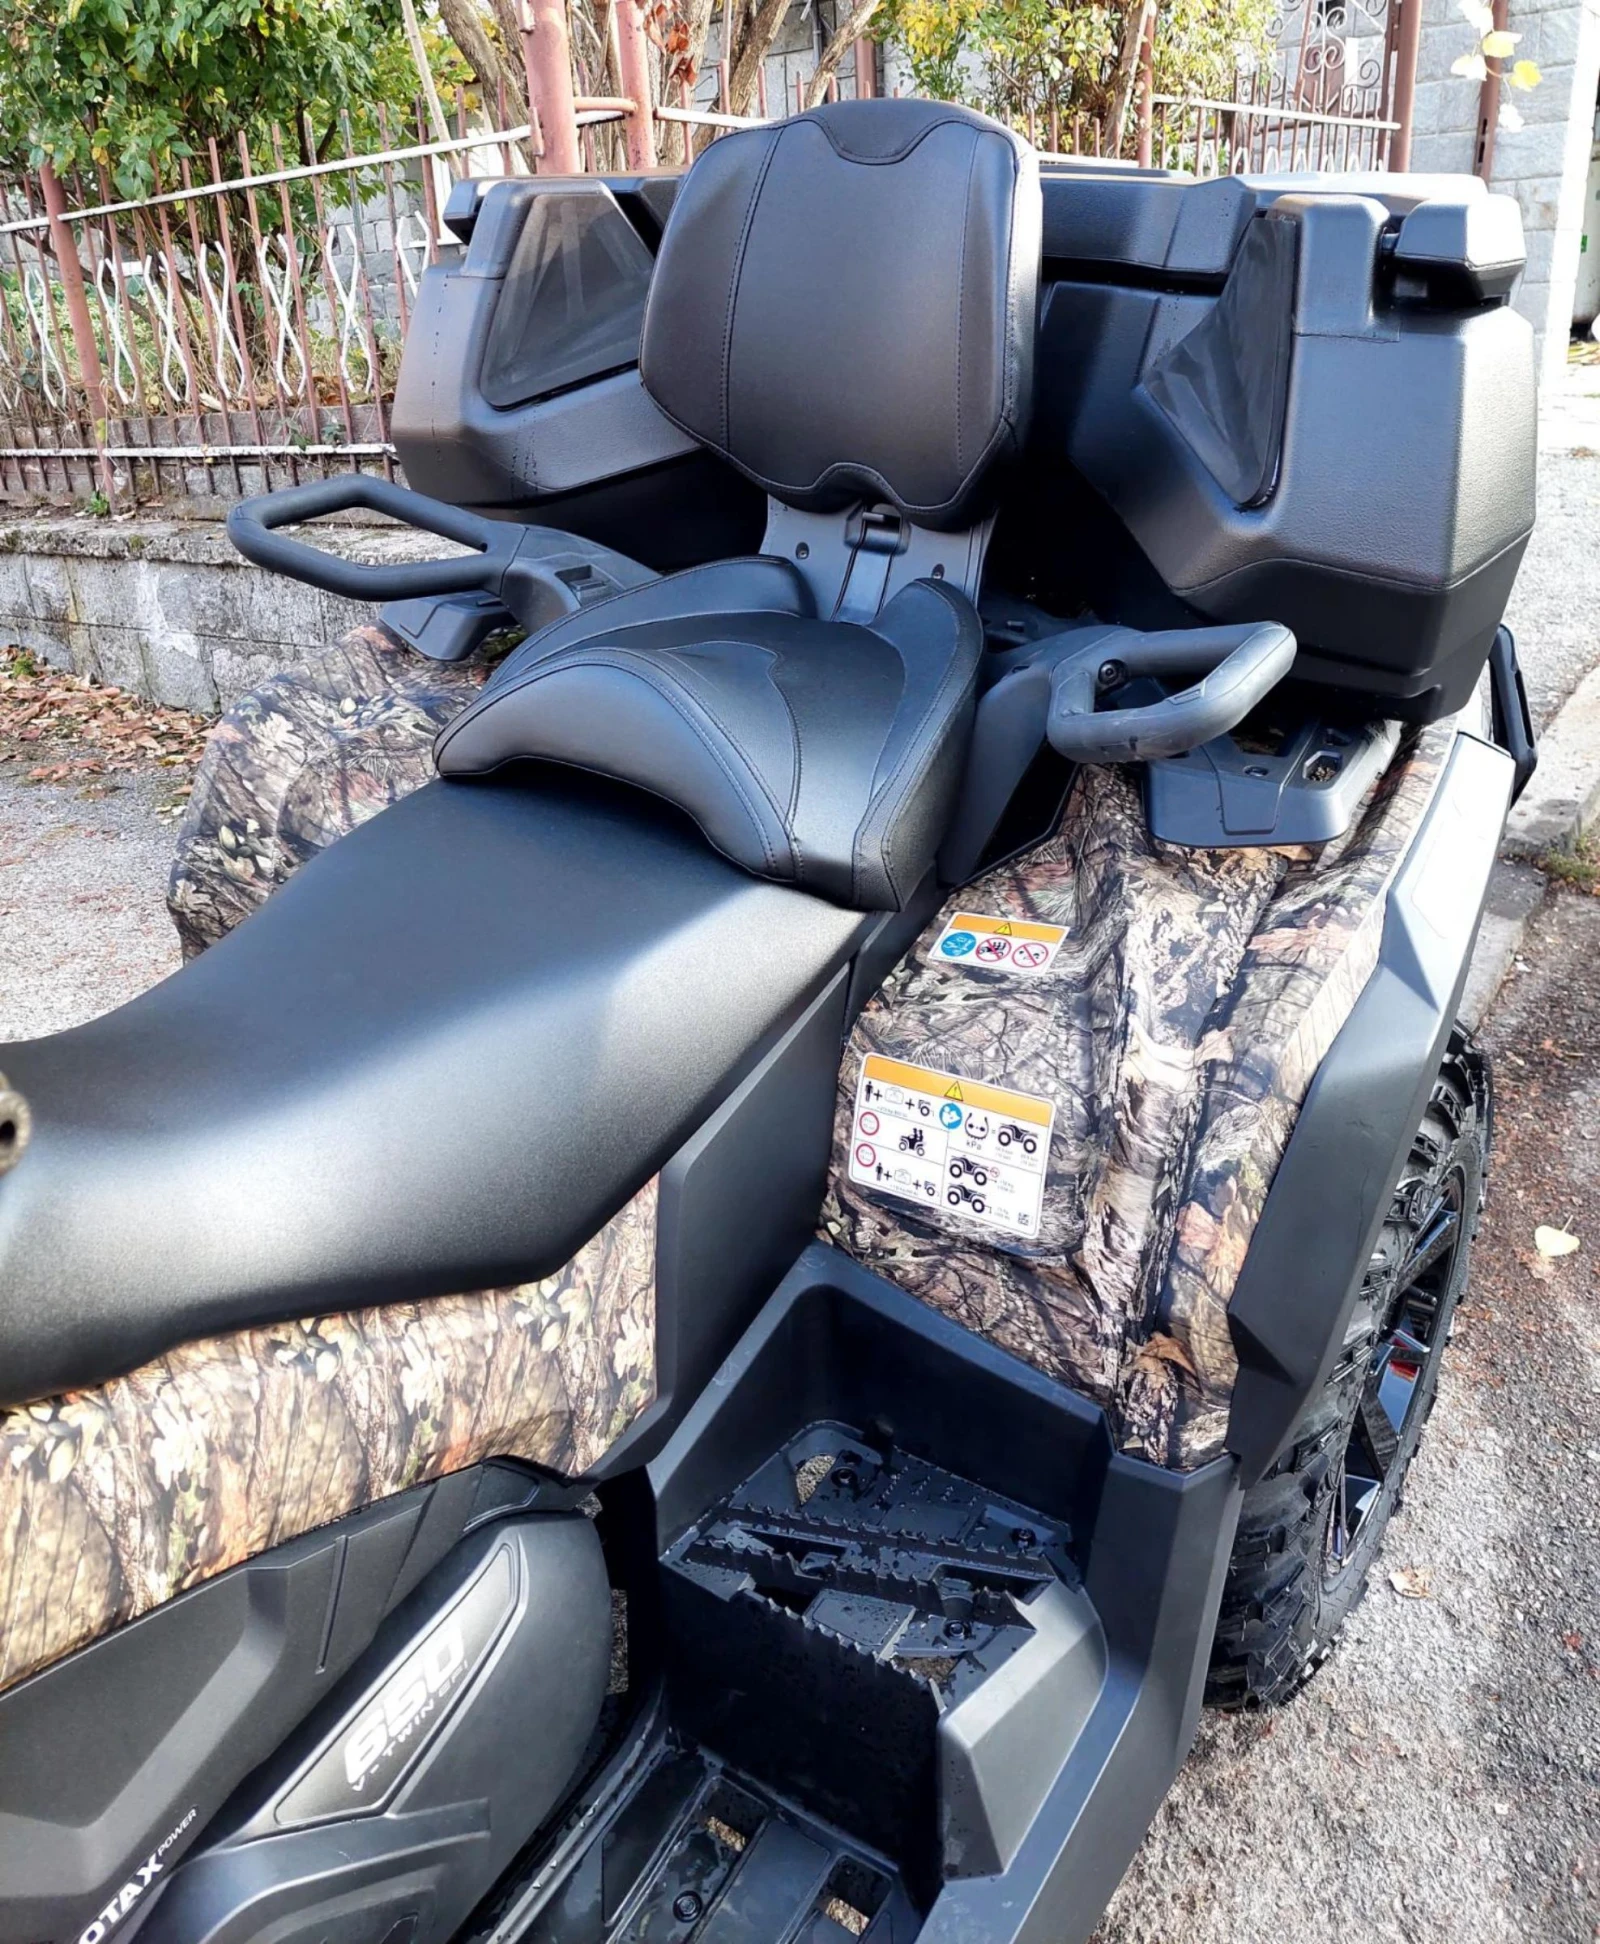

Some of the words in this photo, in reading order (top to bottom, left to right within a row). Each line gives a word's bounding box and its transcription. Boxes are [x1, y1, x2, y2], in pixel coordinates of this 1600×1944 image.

[343, 1624, 465, 1784] 650
[351, 1698, 434, 1792] V-TWIN
[439, 1660, 468, 1698] EFI
[157, 1808, 197, 1856] POWER
